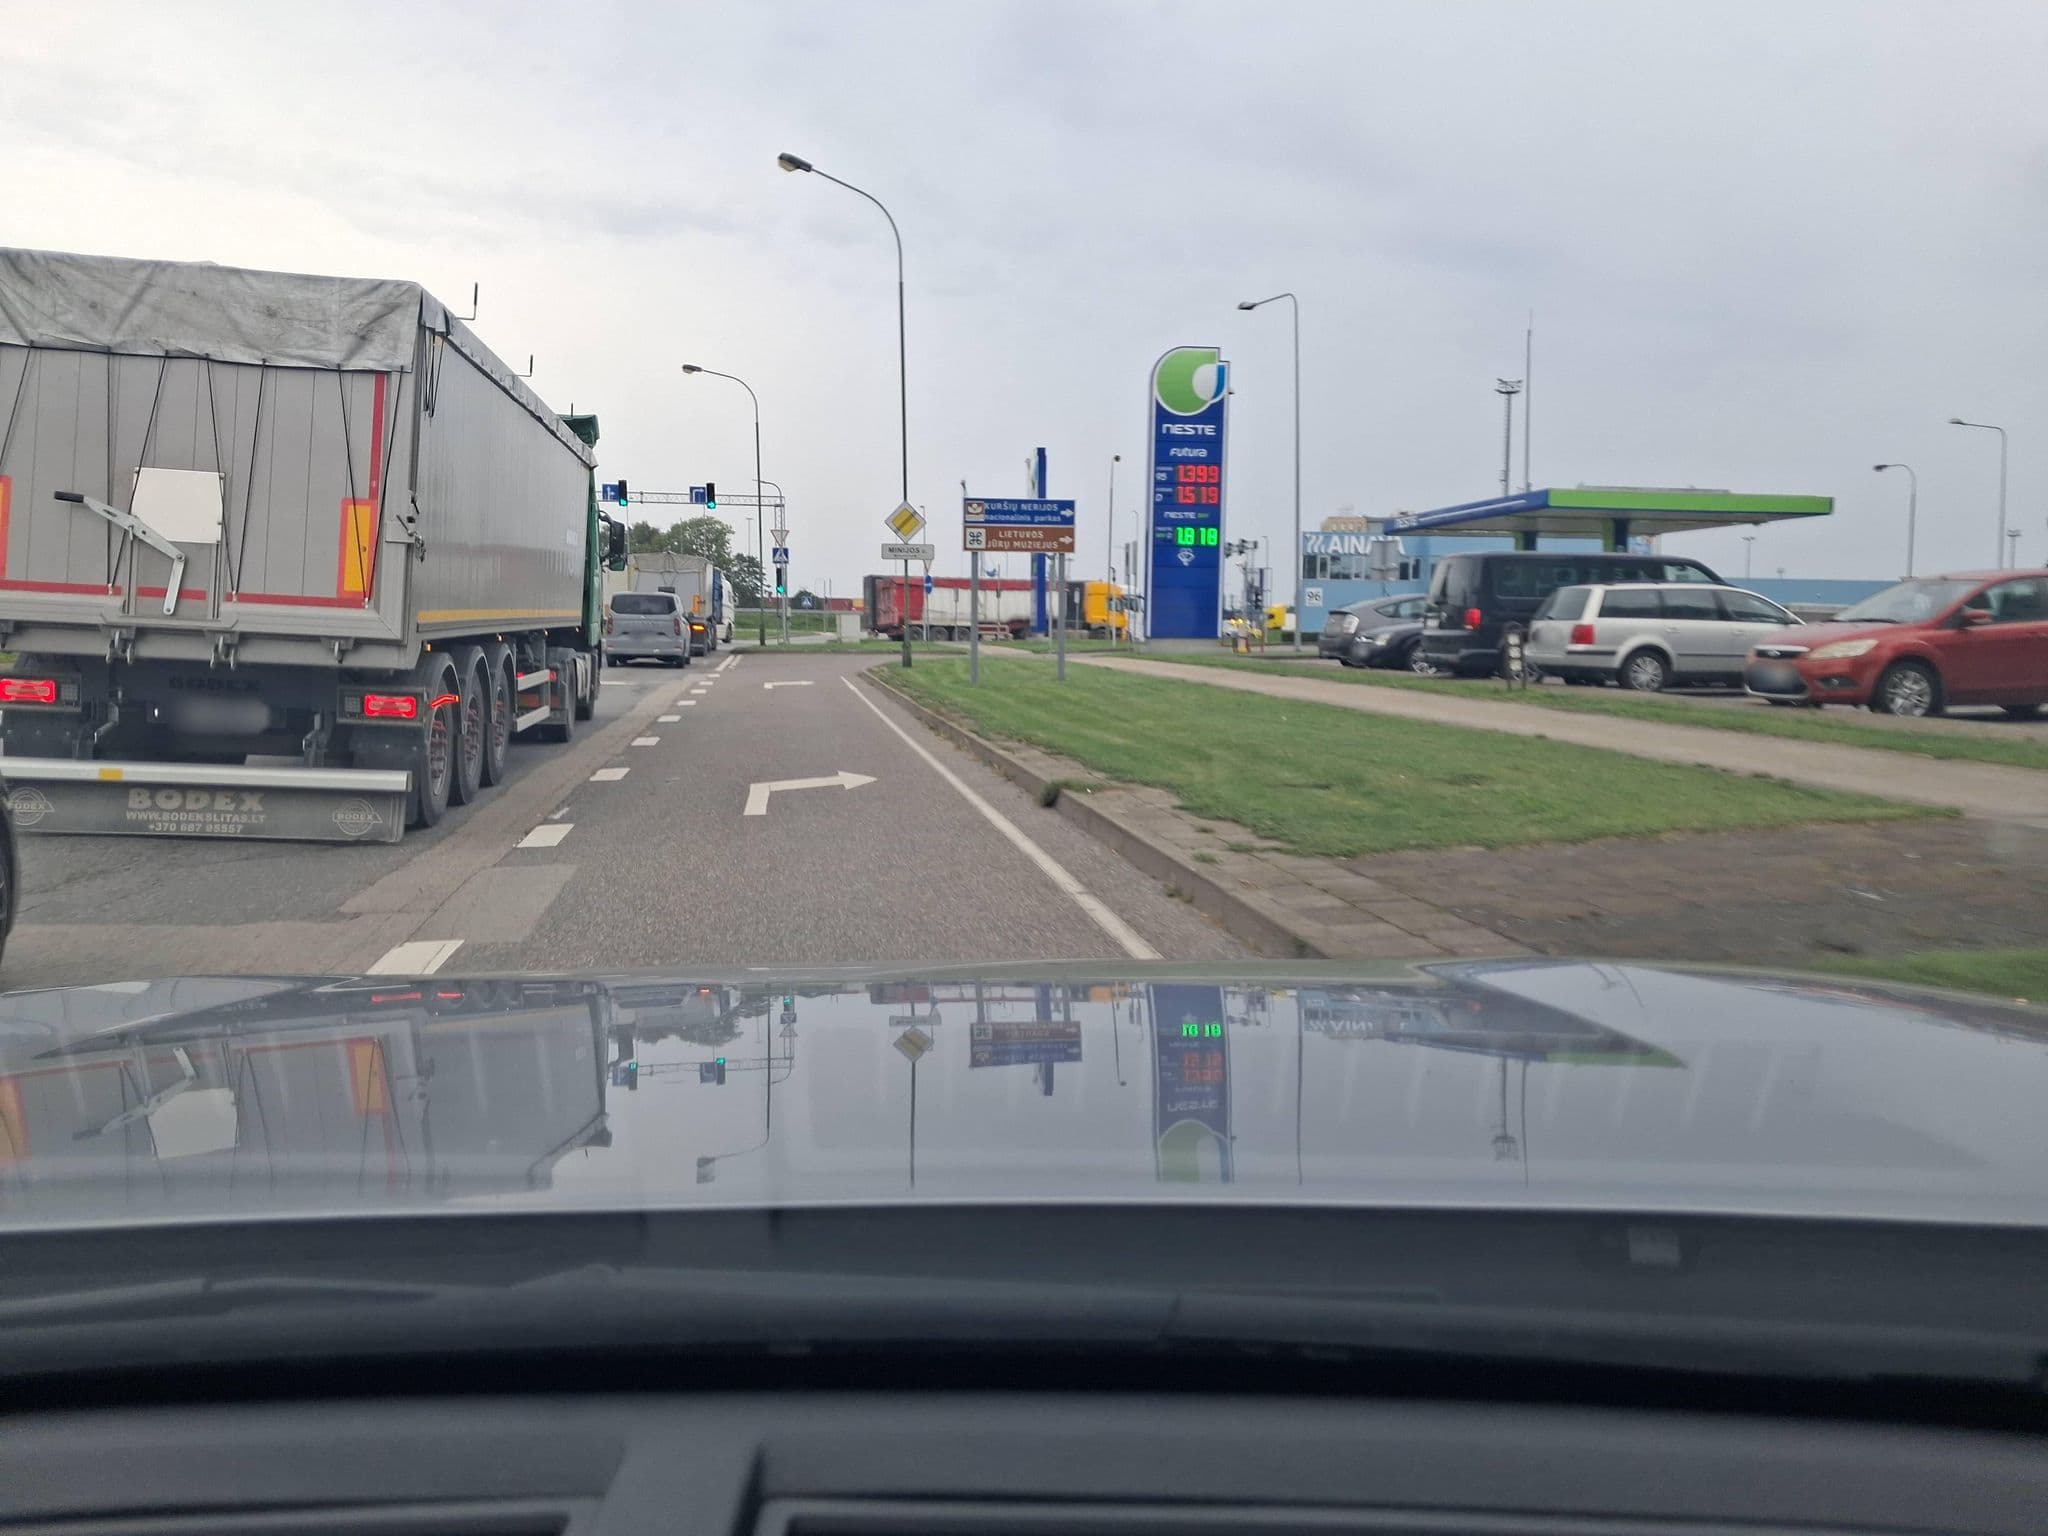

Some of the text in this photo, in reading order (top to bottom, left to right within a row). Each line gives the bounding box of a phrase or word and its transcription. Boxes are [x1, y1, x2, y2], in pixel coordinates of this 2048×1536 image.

[1162, 424, 1216, 435] NESTE
[1021, 503, 1058, 511] NERIJOS
[999, 530, 1044, 538] LIETUVOS
[987, 539, 1058, 549] JŪRŲ MUZIEJUS
[128, 787, 265, 811] BODEX
[148, 823, 177, 832] +370
